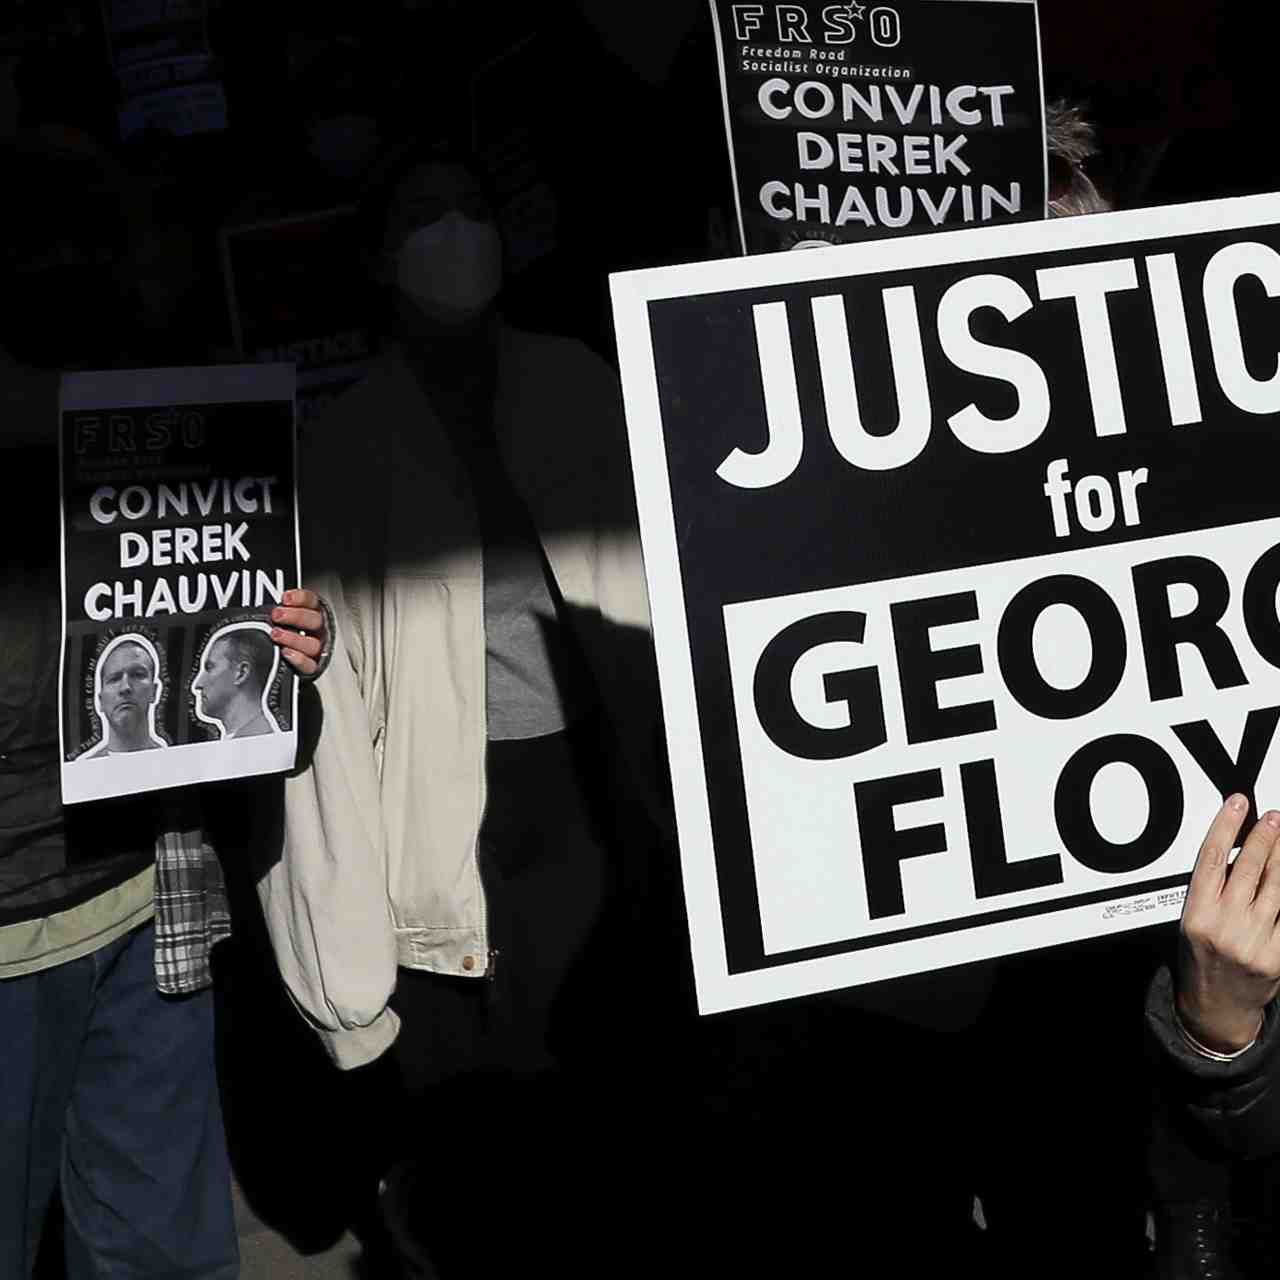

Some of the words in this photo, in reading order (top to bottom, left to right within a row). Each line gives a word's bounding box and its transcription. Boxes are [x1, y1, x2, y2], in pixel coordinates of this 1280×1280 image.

[732, 1, 901, 48] FRSO
[742, 46, 802, 59] Freedom
[810, 48, 846, 61] Road
[742, 60, 809, 74] Socialist
[816, 64, 911, 79] Organization
[758, 78, 1016, 127] CONVICT
[797, 131, 972, 176] DEREK
[758, 180, 1022, 228] CHAUVIN
[89, 474, 280, 525] CONVICT
[1043, 458, 1152, 538] for
[118, 521, 252, 569] DEREK
[83, 568, 287, 622] CHAUVIN
